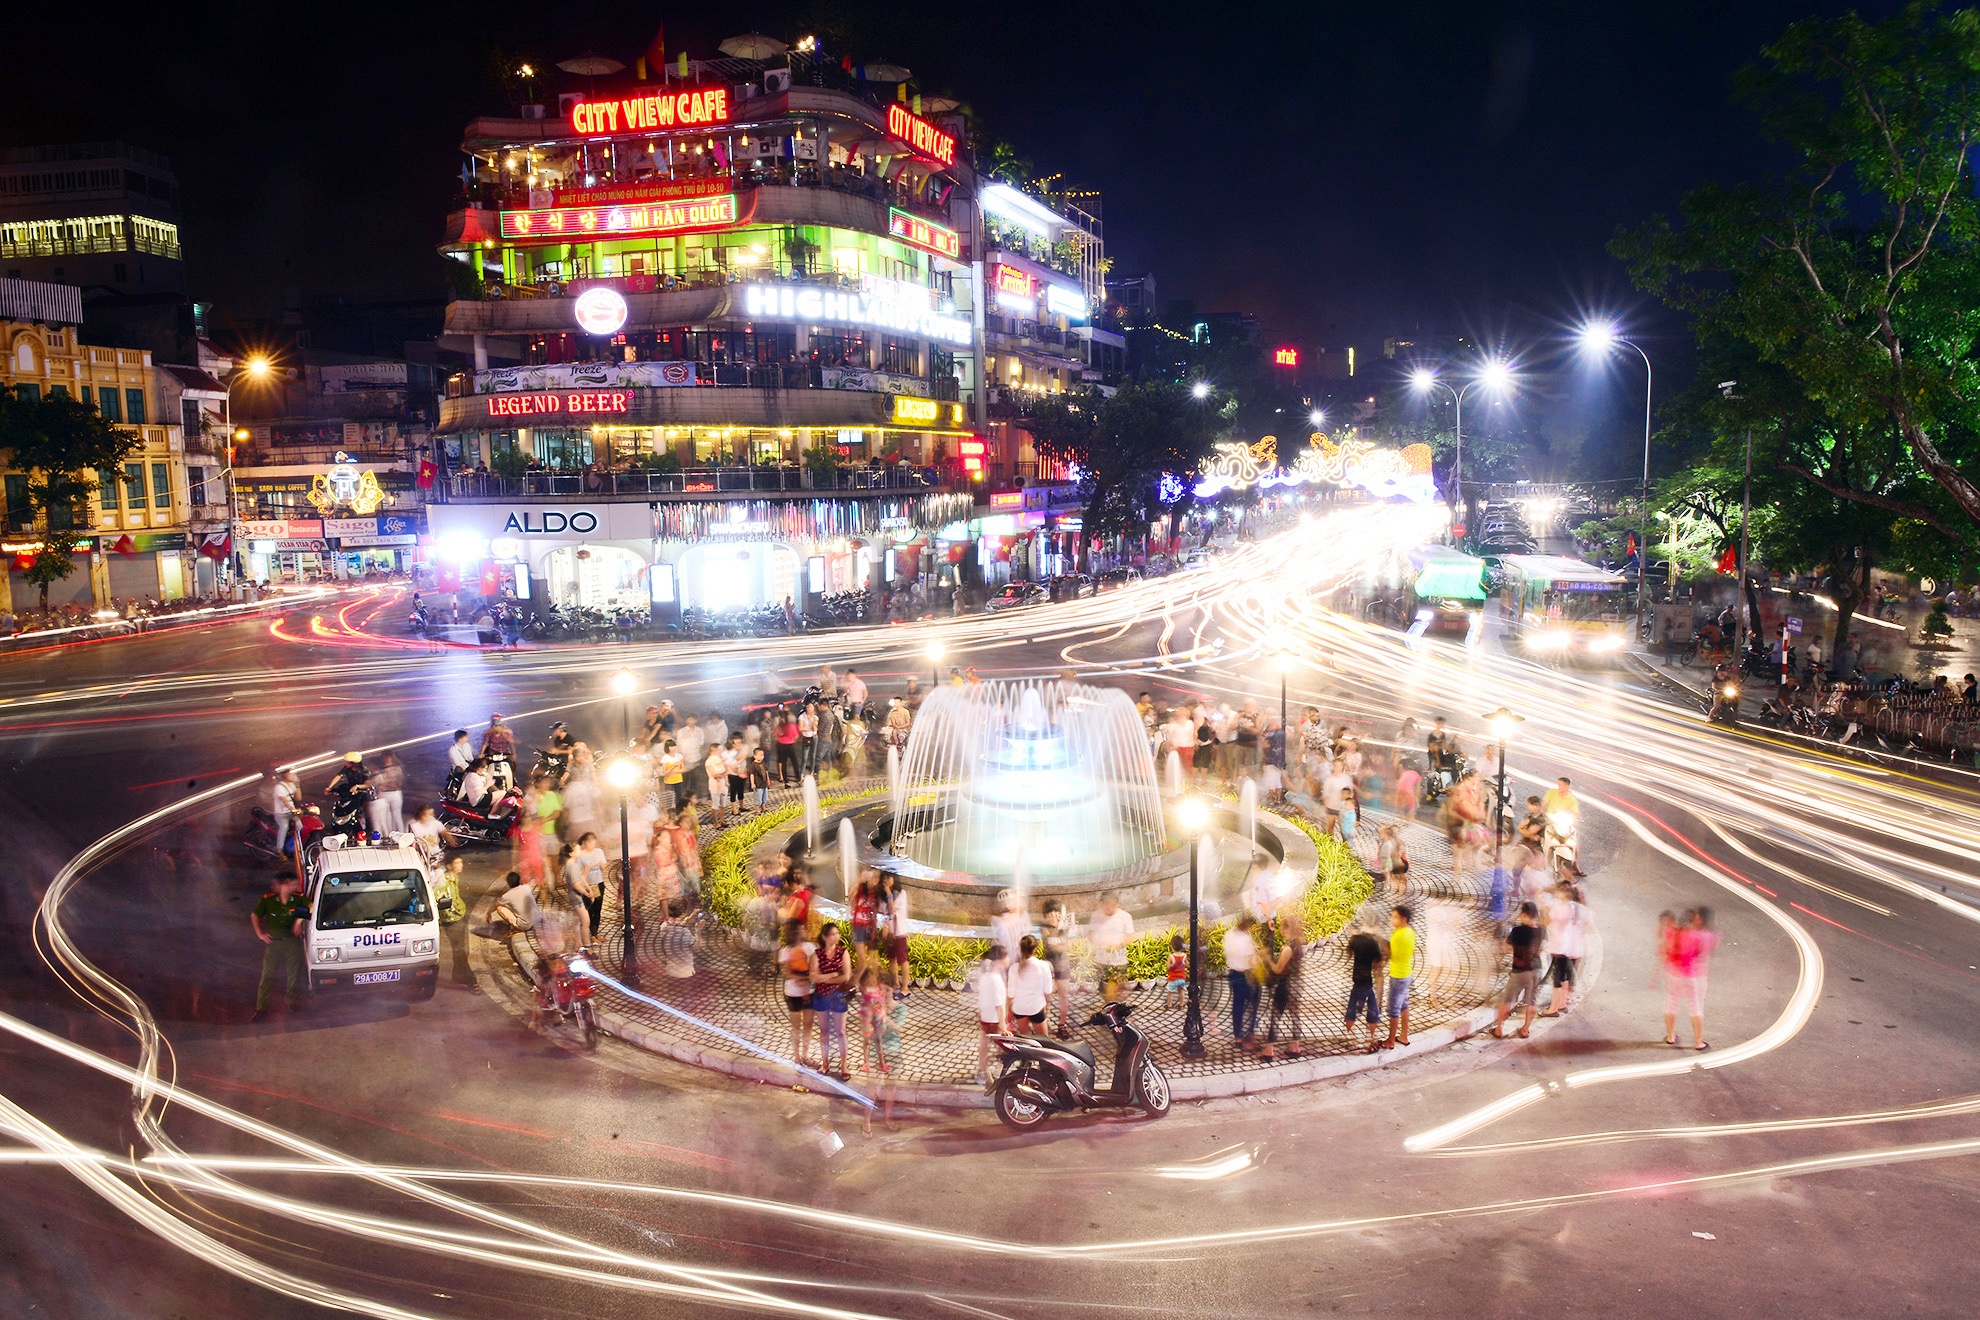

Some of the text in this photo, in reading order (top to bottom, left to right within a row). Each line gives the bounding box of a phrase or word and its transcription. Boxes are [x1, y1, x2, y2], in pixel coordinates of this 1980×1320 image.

[573, 89, 727, 133] CITY VIEW CAFE
[889, 105, 953, 165] CITY VIEW CAFE
[559, 194, 576, 205] NHIỆT
[577, 192, 590, 204] LIỆT
[591, 191, 607, 202] CHÀO
[626, 189, 634, 198] 60
[662, 185, 682, 196] PHÓNG
[706, 182, 724, 193] 10-10
[630, 199, 728, 228] MÌ HÀN QUỐC
[748, 286, 919, 332] HIGHLANDS
[919, 311, 971, 344] COFFEE
[491, 370, 514, 380] freeze
[570, 366, 602, 376] freeze
[488, 393, 627, 416] LEGEND BEER
[287, 483, 306, 491] COFFEE
[289, 524, 320, 533] Restaurant
[326, 520, 375, 531] Sago
[383, 517, 407, 534] Tiger
[504, 512, 598, 533] ALDO
[353, 932, 401, 947] POLICE
